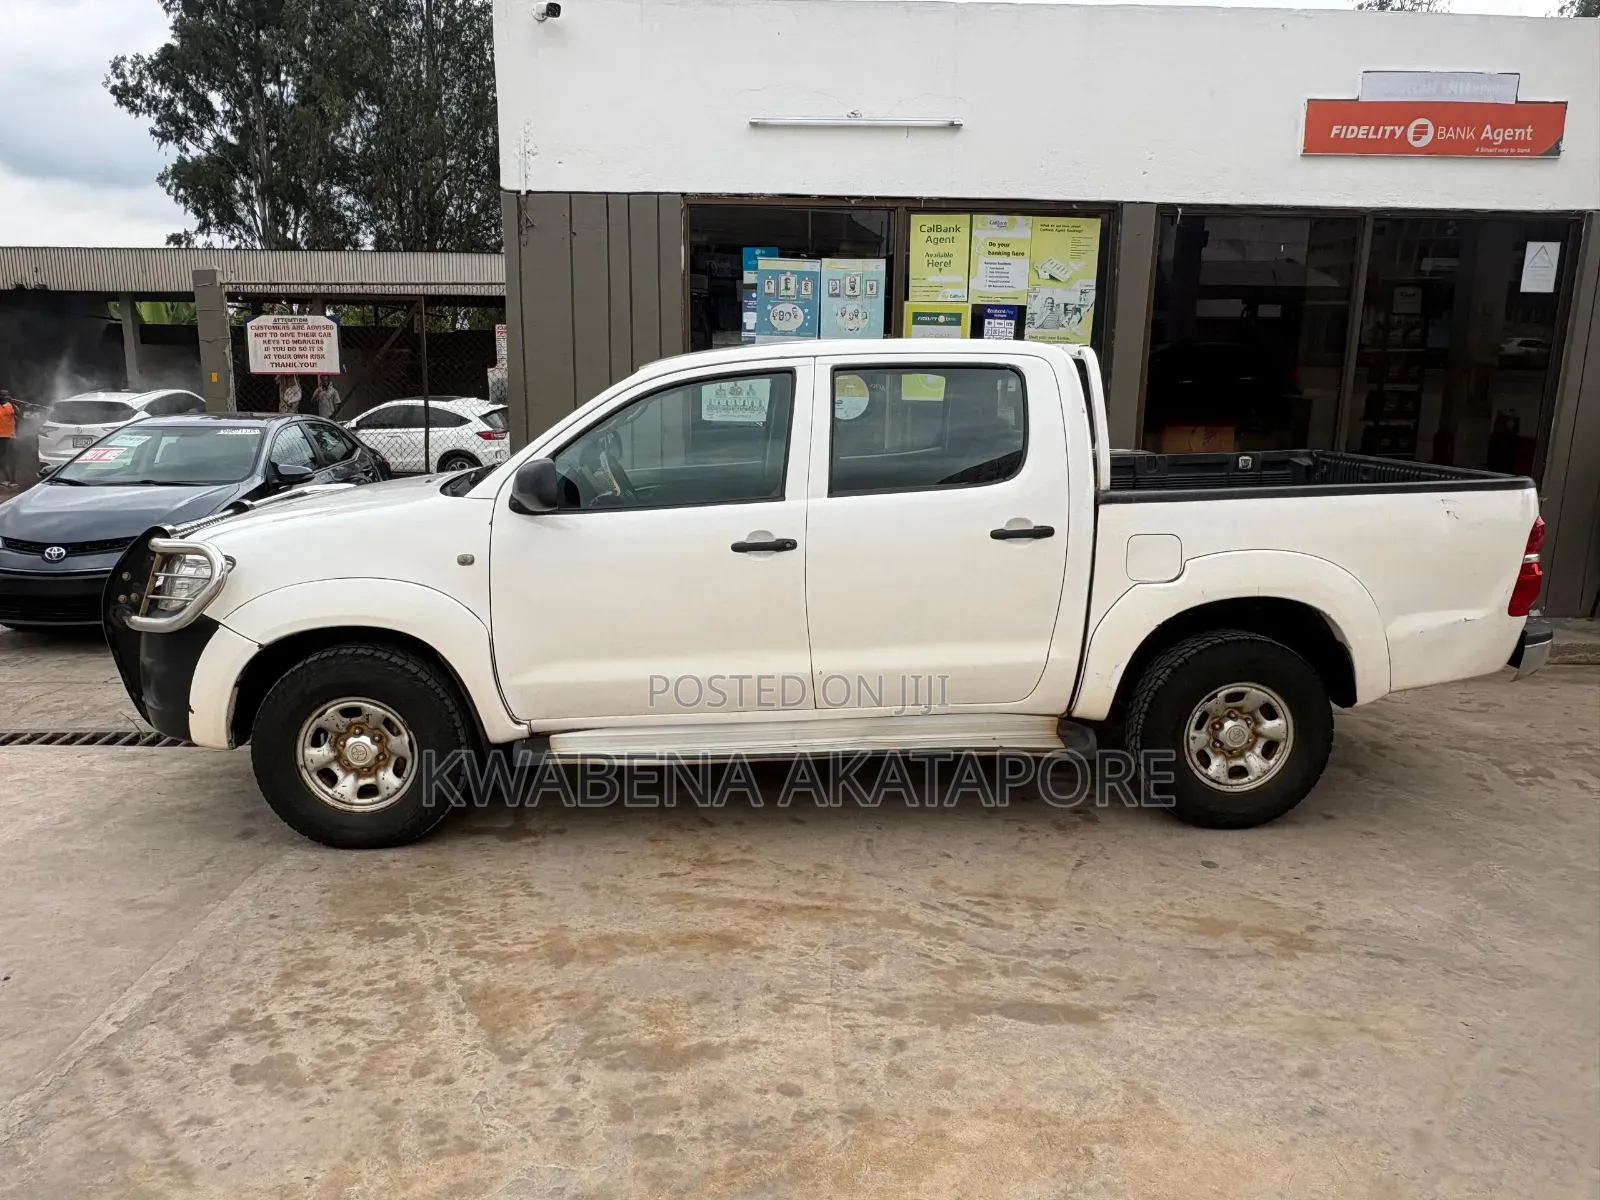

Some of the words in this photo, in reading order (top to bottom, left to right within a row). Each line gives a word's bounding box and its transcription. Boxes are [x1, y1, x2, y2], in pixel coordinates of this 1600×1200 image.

[1330, 125, 1404, 139] FIDELITY
[1437, 126, 1476, 140] BANK
[1480, 124, 1533, 145] Agent
[919, 224, 961, 233] CalBank
[925, 235, 955, 245] Agent
[926, 259, 952, 268] Here!
